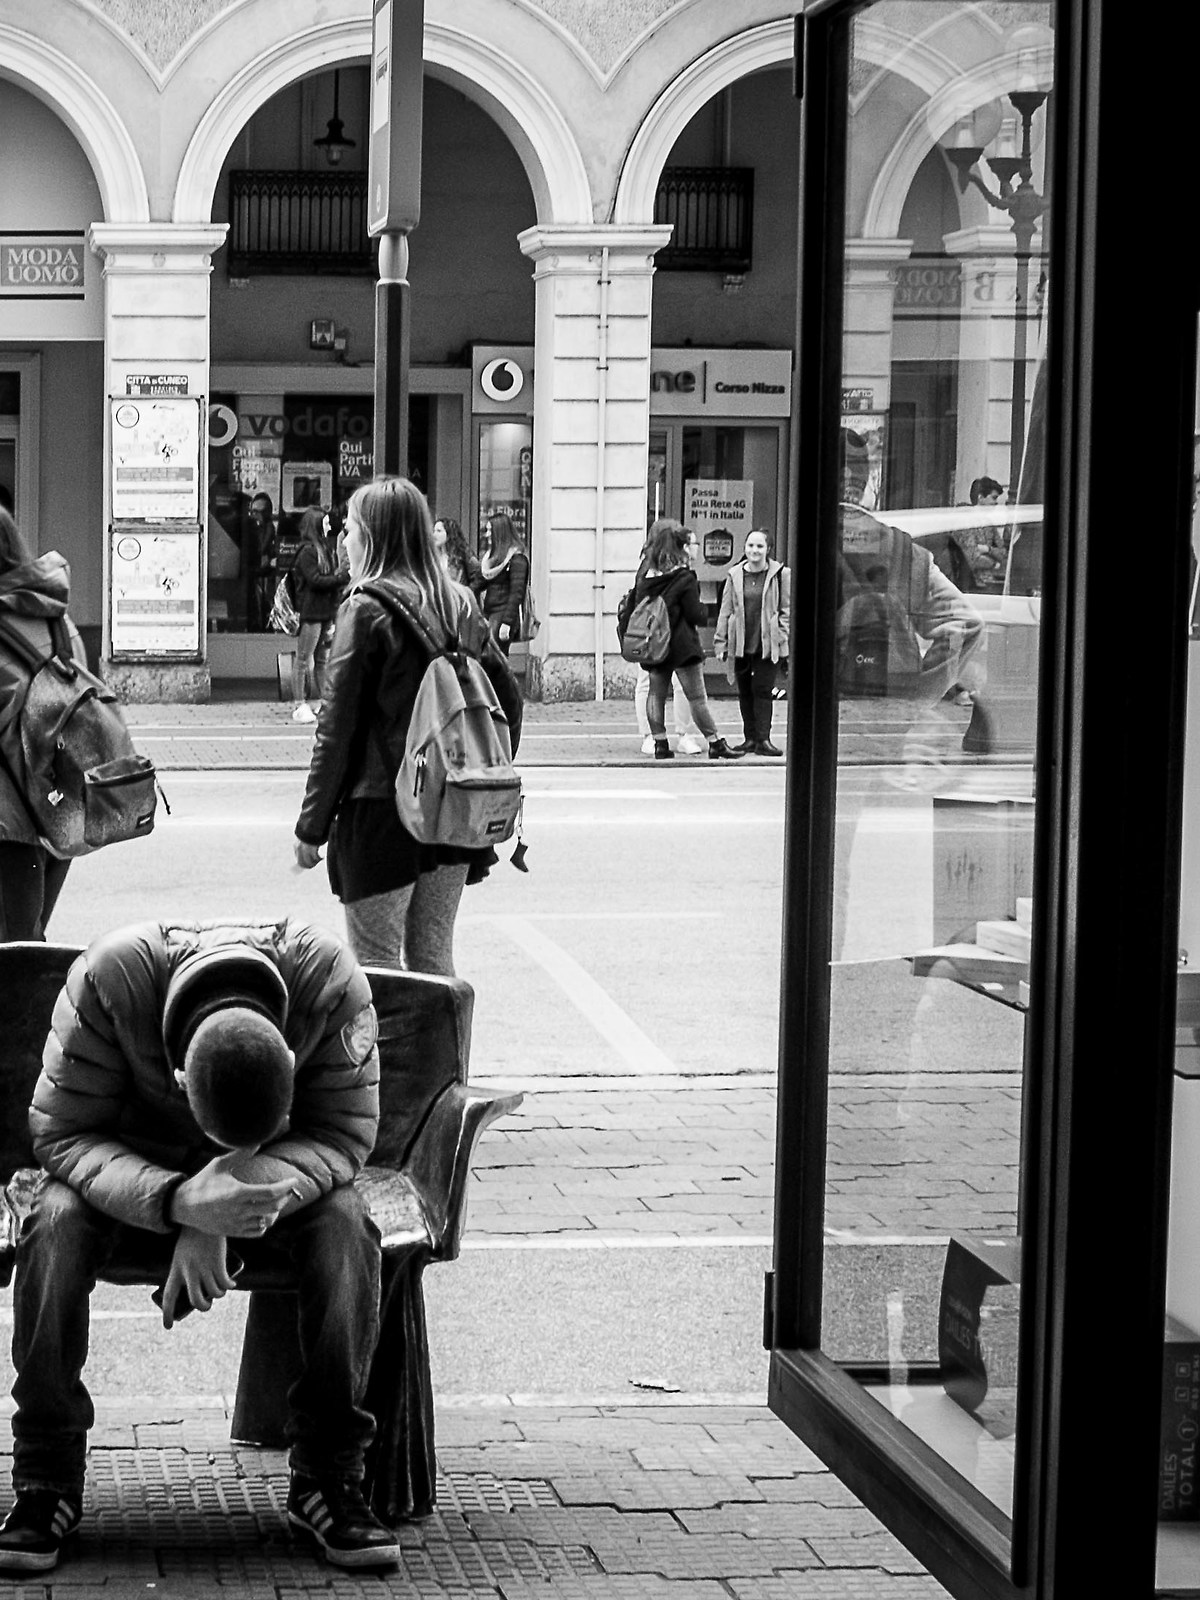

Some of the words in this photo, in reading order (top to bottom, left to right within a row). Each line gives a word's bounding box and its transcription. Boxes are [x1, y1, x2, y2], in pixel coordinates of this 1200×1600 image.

[7, 247, 79, 266] MODA
[7, 264, 79, 284] UOMO
[158, 376, 187, 385] CUNEO
[715, 381, 749, 394] Corso
[752, 382, 785, 394] Nizza
[248, 406, 371, 437] vodafo
[340, 441, 362, 454] Qui
[340, 453, 374, 466] Parti
[340, 465, 360, 477] IVA
[691, 488, 718, 497] Passa
[691, 499, 708, 508] alla
[710, 499, 731, 509] Rete
[733, 499, 746, 509] 4G
[710, 510, 718, 519] in
[720, 510, 744, 519] Italia
[1161, 1453, 1178, 1510] DAILIES
[1179, 1442, 1196, 1509] TOTAL
